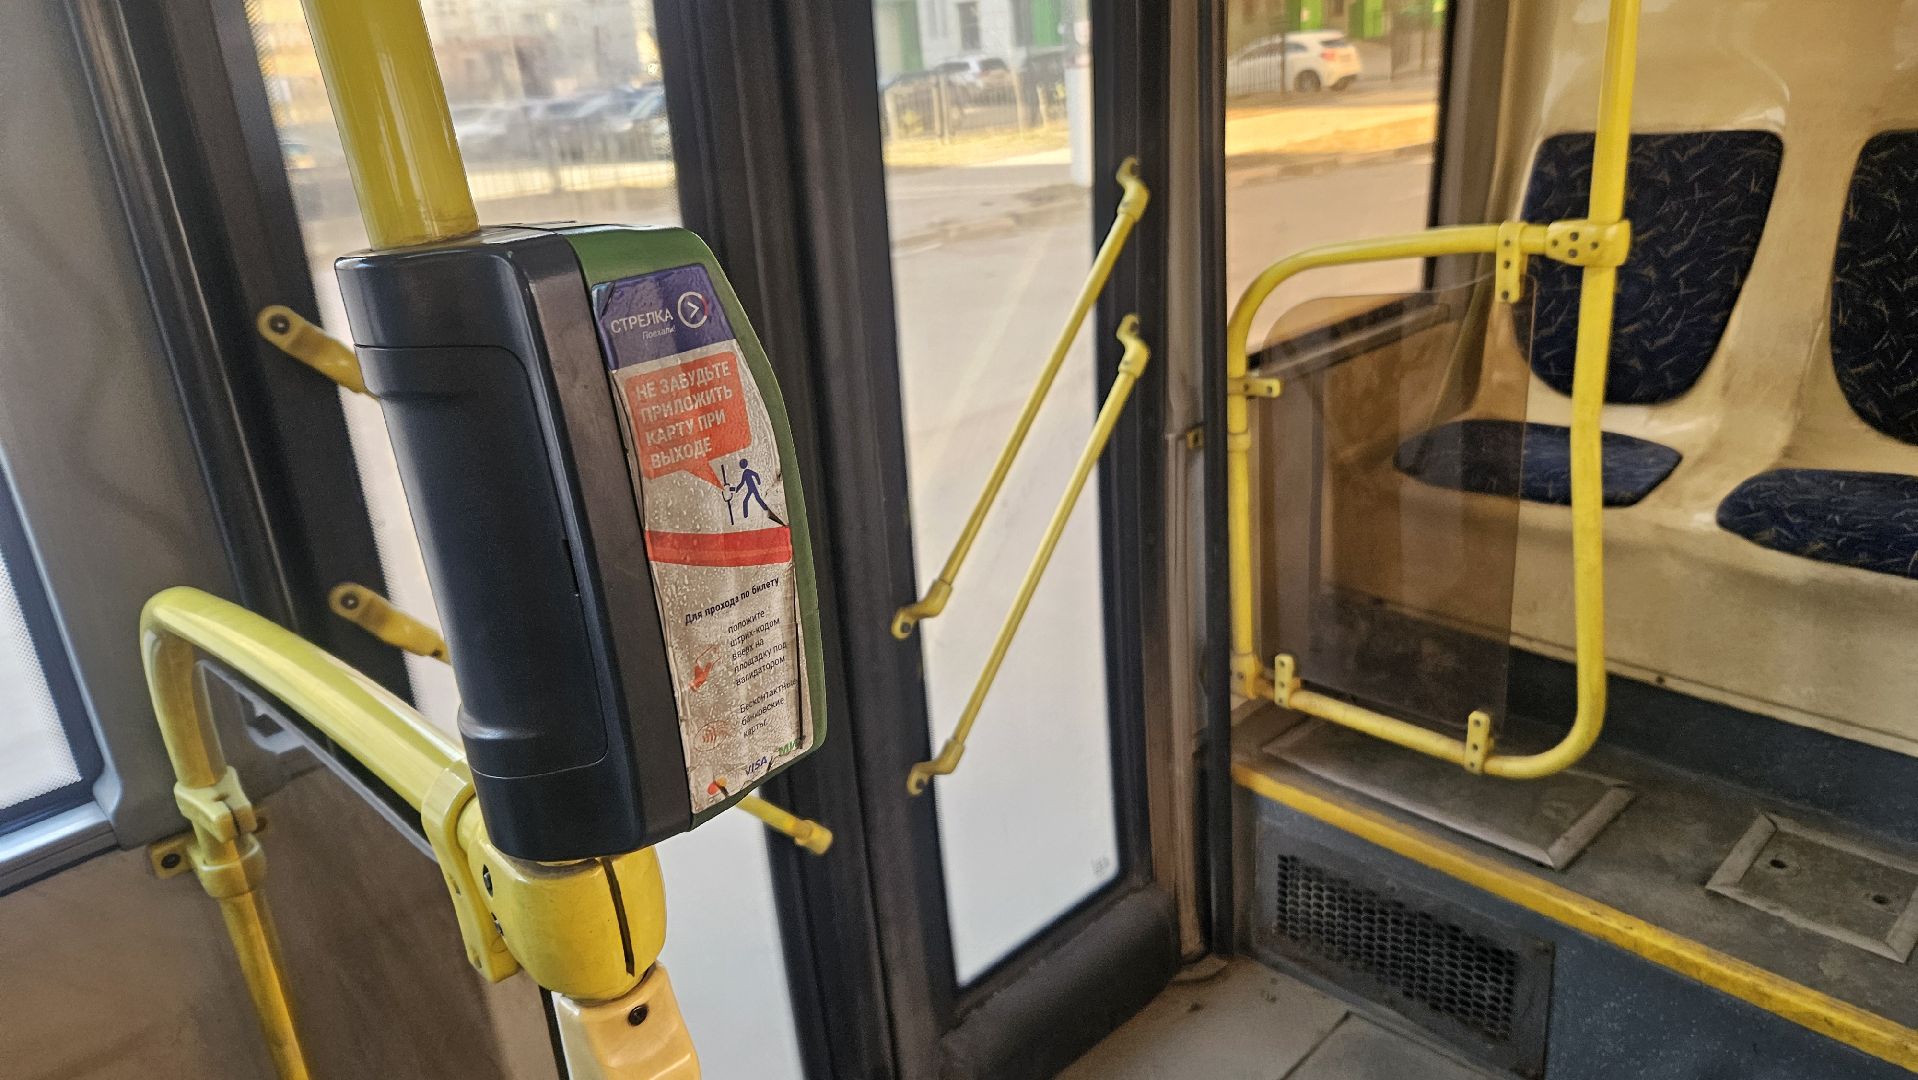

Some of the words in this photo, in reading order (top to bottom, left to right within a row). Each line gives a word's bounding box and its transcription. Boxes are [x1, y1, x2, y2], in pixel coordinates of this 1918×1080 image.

[610, 307, 674, 334] СТРЕЛКА
[635, 380, 656, 402] НЕ
[660, 361, 732, 394] ЗАБУДЬТЕ
[640, 386, 733, 424] ПРИЛОЖИТЬ
[646, 420, 695, 447] КАРТУ
[698, 410, 726, 431] ПРИ
[650, 437, 713, 469] ВЫХОДЕ
[685, 611, 703, 626] Для
[704, 596, 740, 617] прохода
[741, 590, 750, 600] по
[752, 577, 779, 595] билету
[728, 610, 765, 634] положите
[730, 617, 780, 647] штрих-кодом
[734, 649, 772, 674] площадку
[773, 641, 788, 652] под
[755, 638, 764, 647] на
[736, 656, 786, 686] валидатором
[741, 698, 785, 726] банковские
[745, 756, 768, 776] VISA
